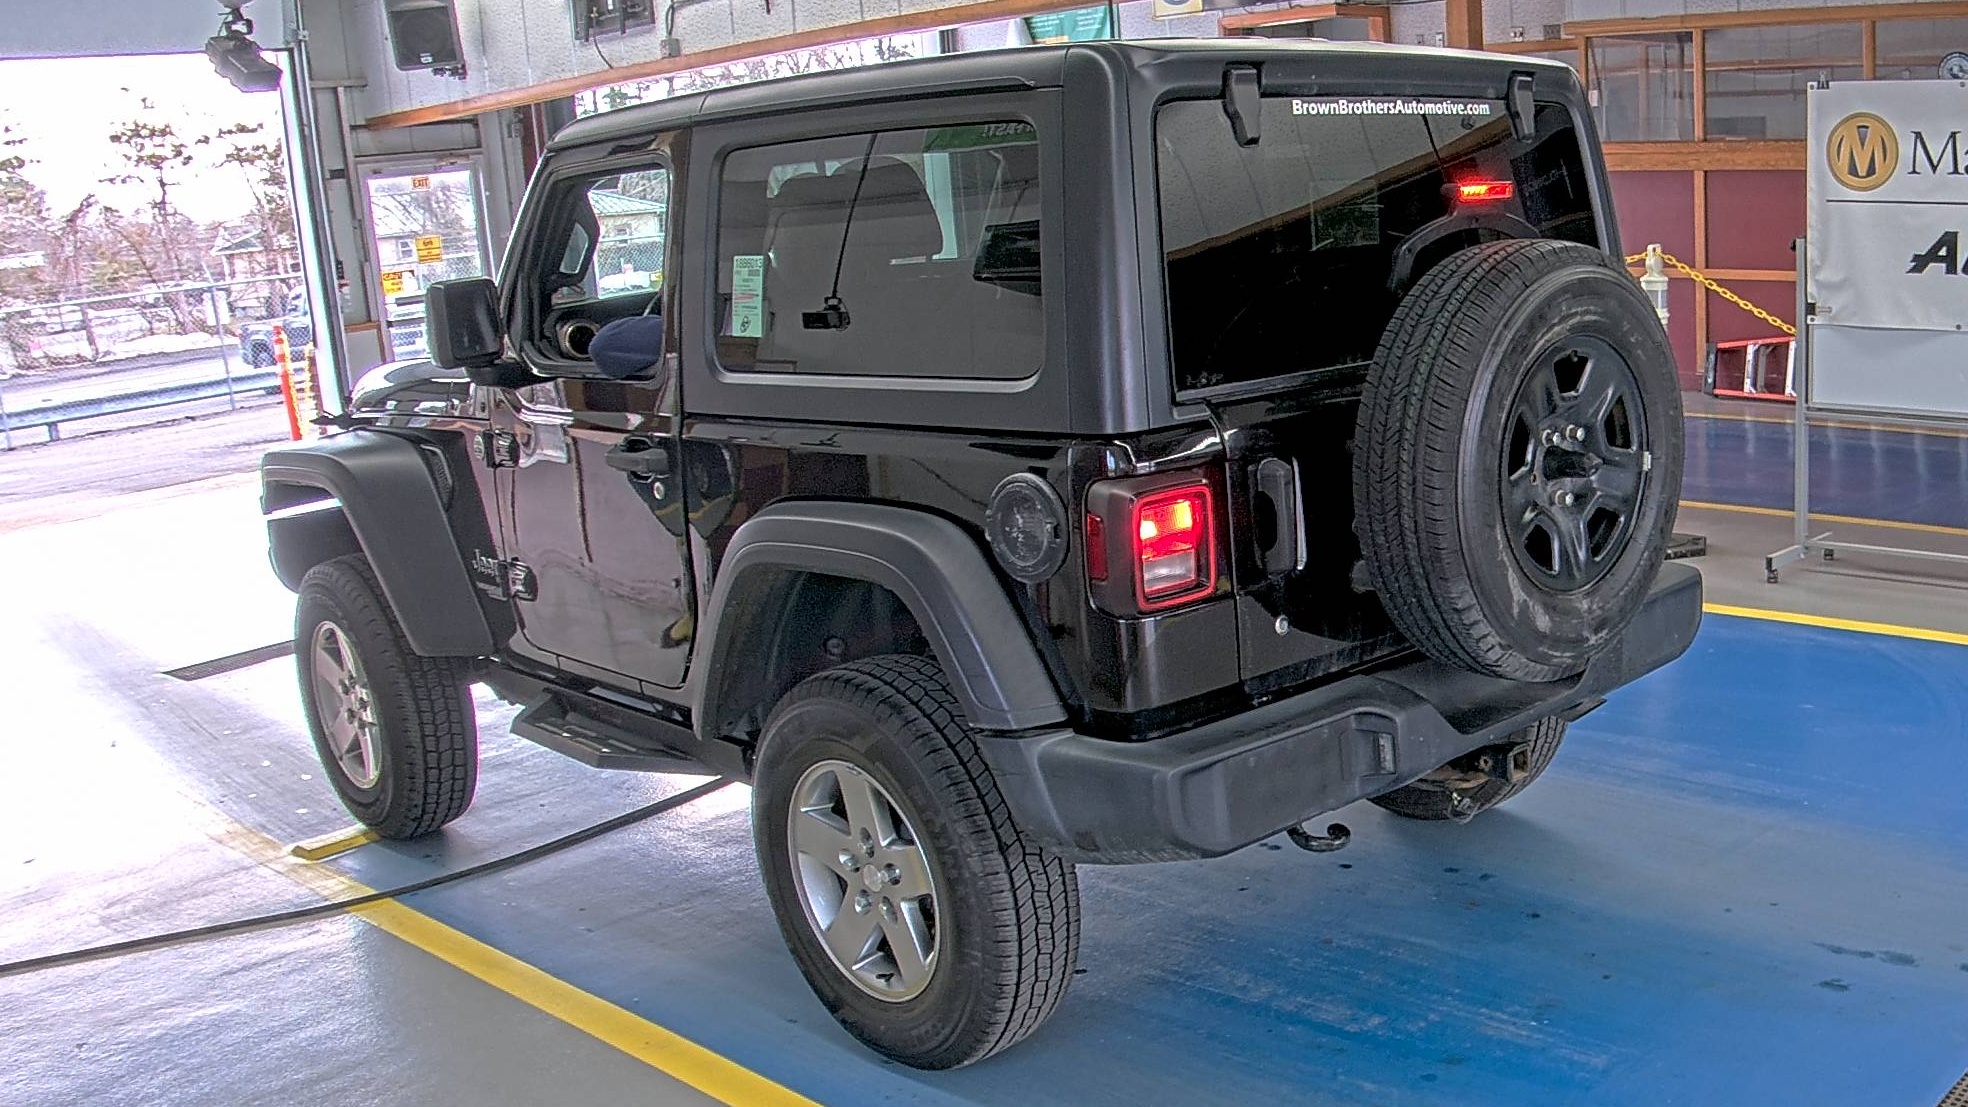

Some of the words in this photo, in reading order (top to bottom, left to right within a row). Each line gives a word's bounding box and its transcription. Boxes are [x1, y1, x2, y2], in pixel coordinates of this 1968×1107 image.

[1292, 99, 1490, 115] BrownBrothersAutomotive.com
[1907, 131, 1968, 175] M
[413, 178, 429, 188] EXIT
[1905, 231, 1968, 275] A
